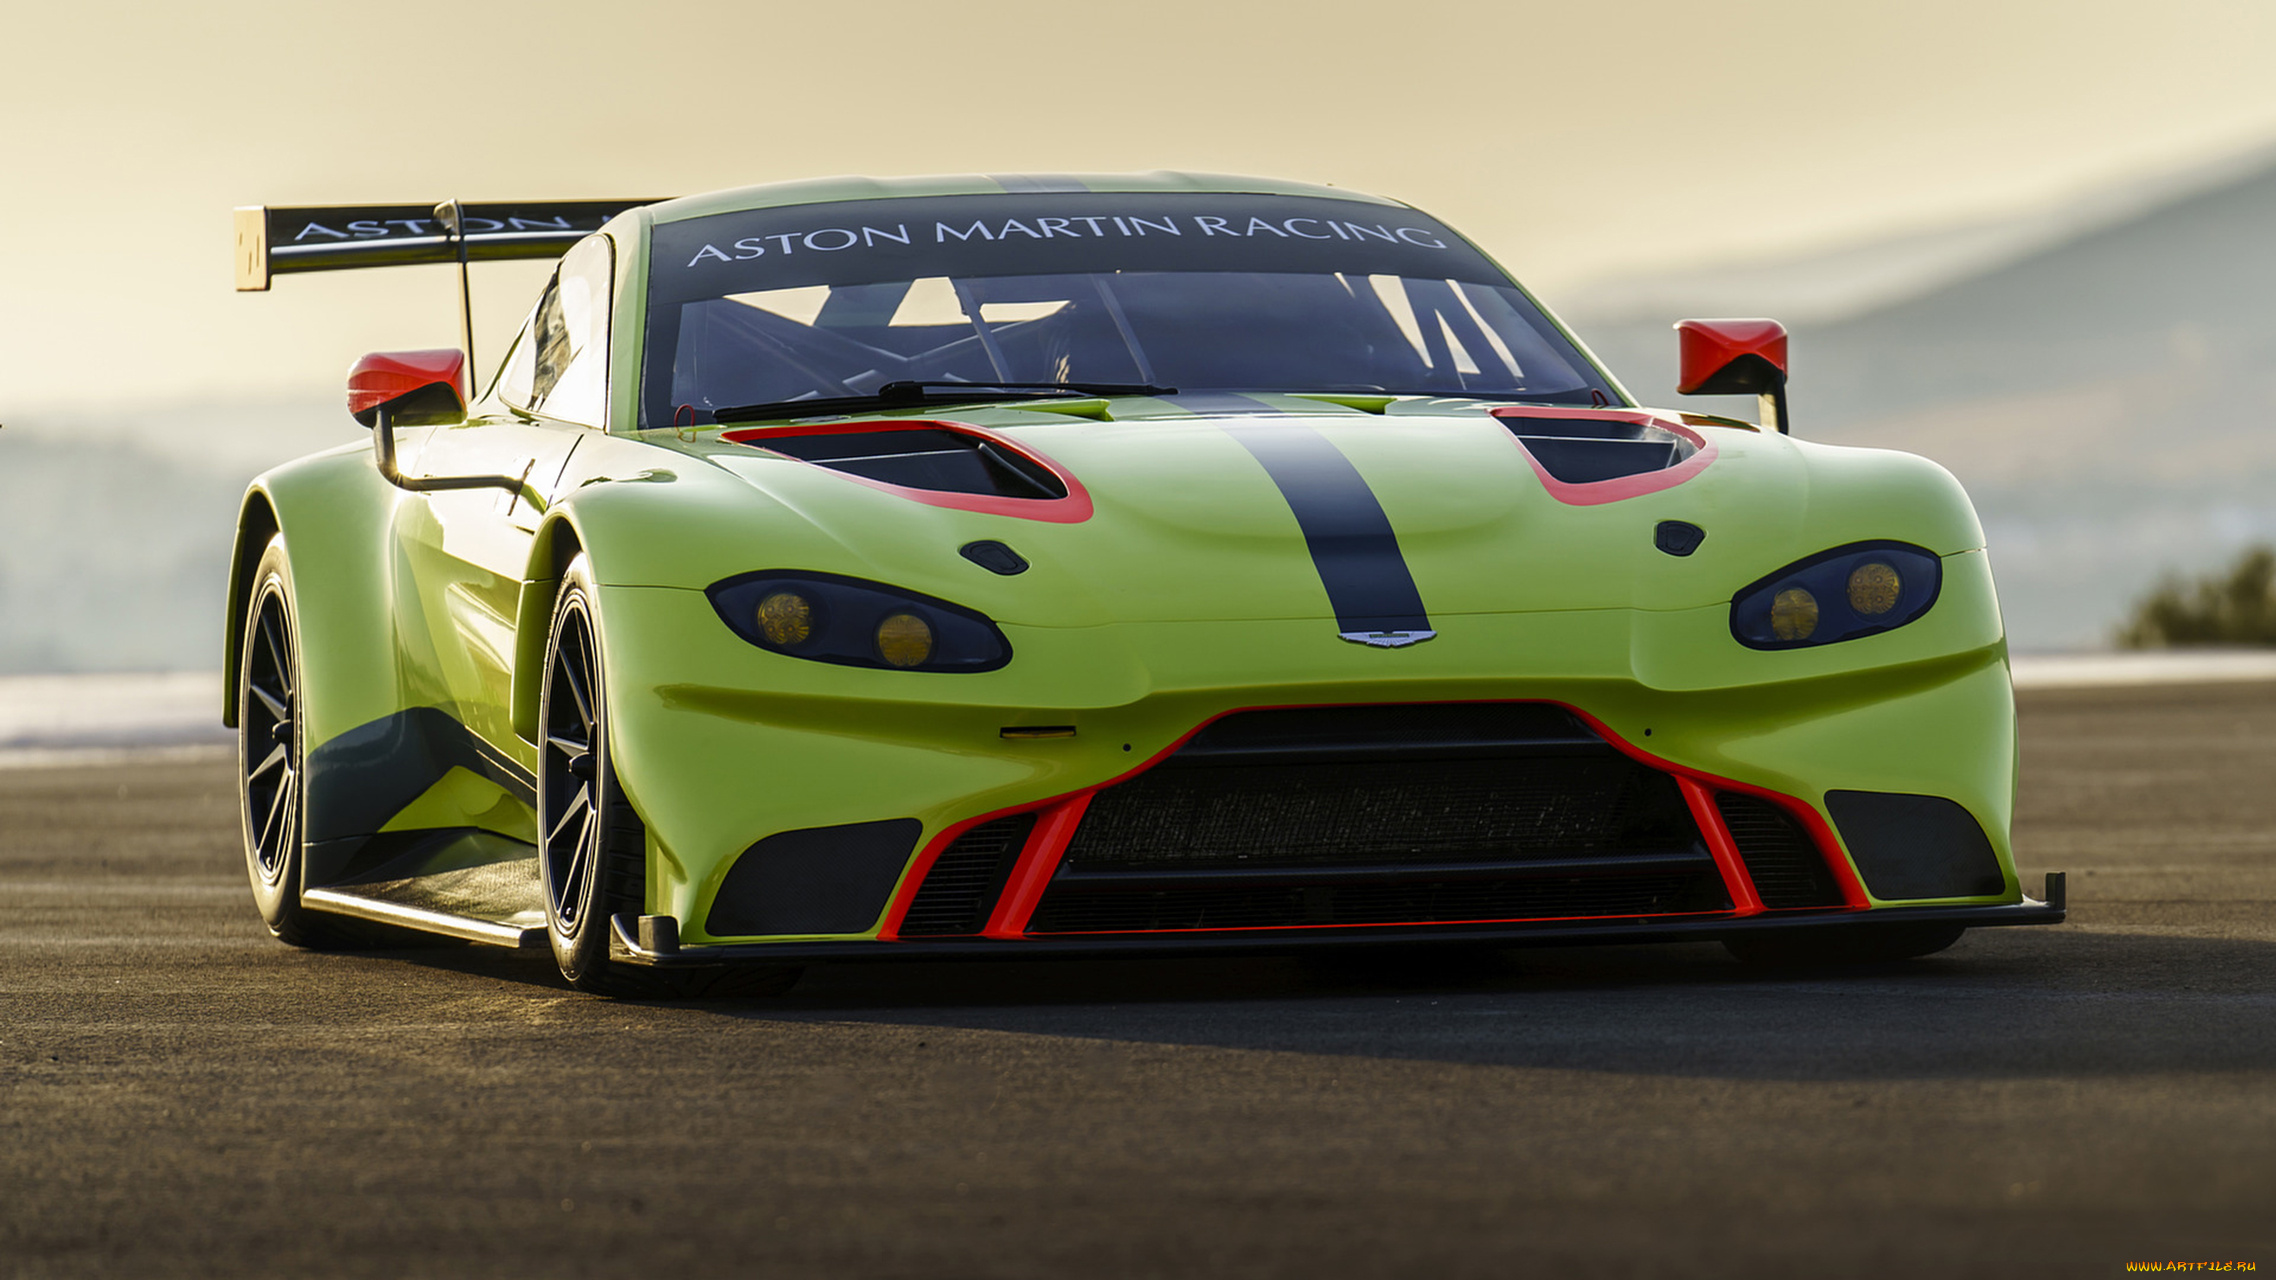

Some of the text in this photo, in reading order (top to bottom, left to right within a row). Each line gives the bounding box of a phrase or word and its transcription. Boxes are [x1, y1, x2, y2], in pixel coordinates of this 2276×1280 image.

[687, 216, 1448, 267] ASTON MARTIN RACING
